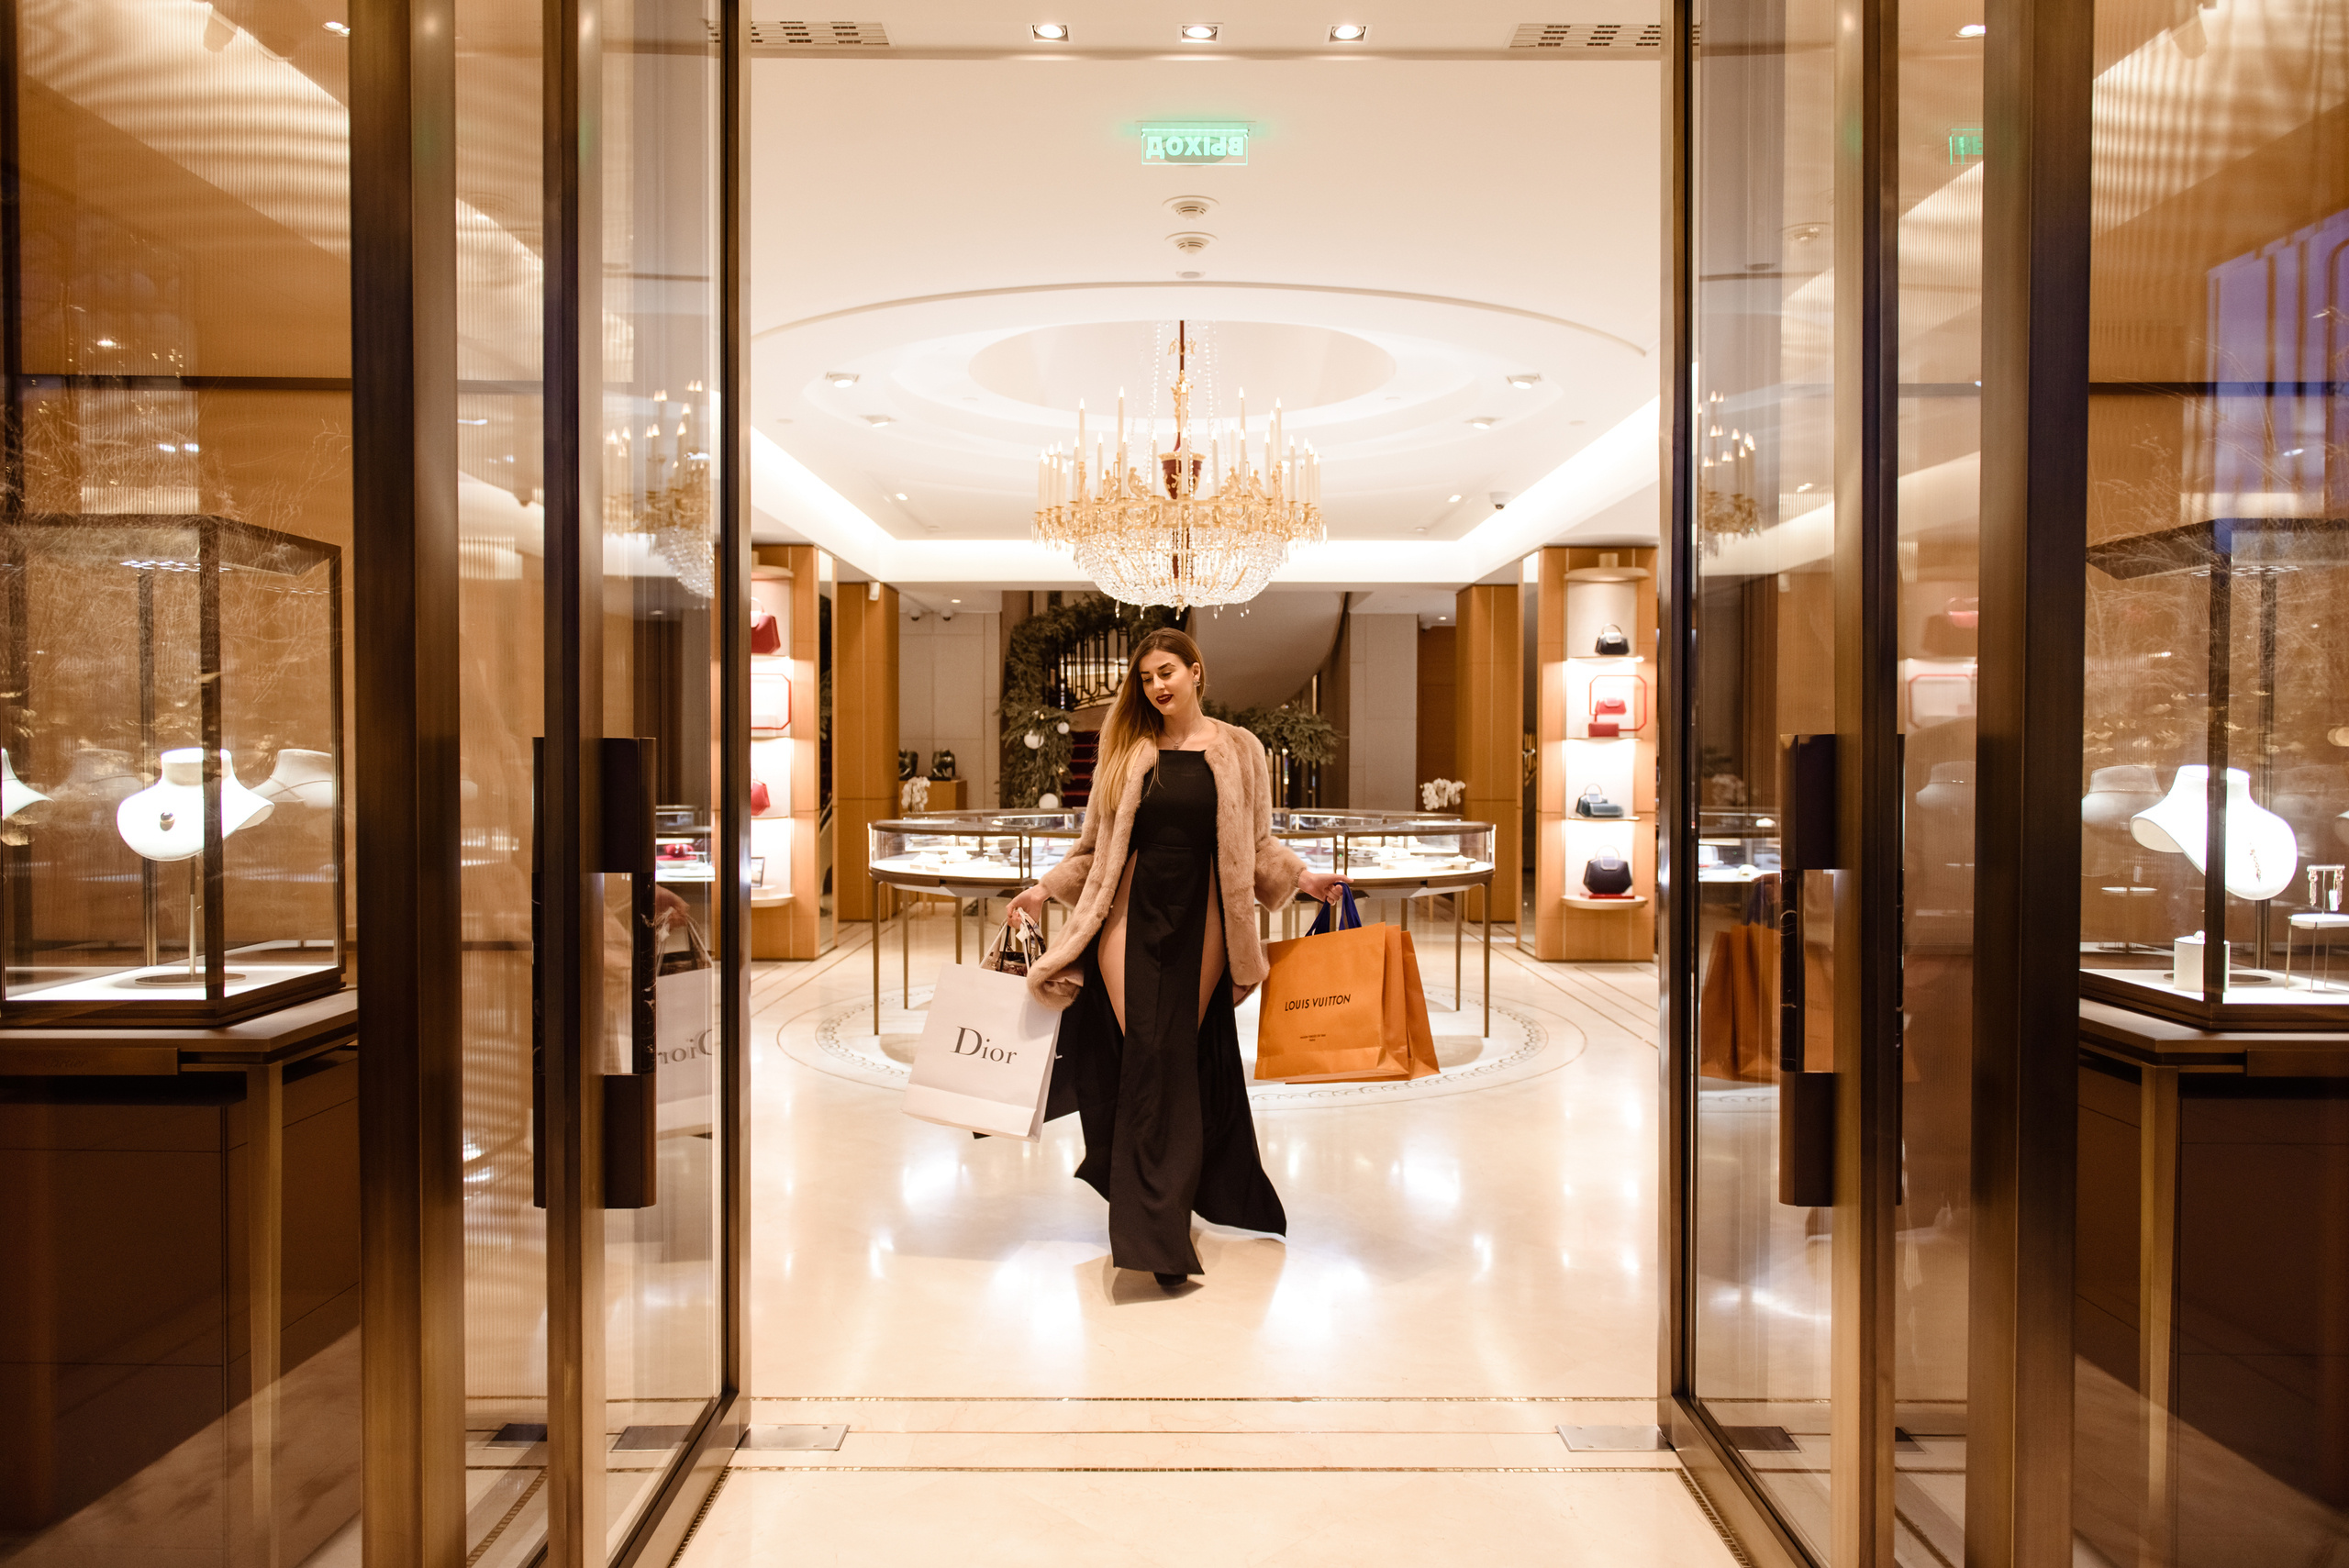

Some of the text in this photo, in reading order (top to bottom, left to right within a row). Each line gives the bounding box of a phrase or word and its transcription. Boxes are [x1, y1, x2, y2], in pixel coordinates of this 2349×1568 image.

[1285, 994, 1352, 1012] LOUIS VUITTON
[949, 1026, 1018, 1064] Dior
